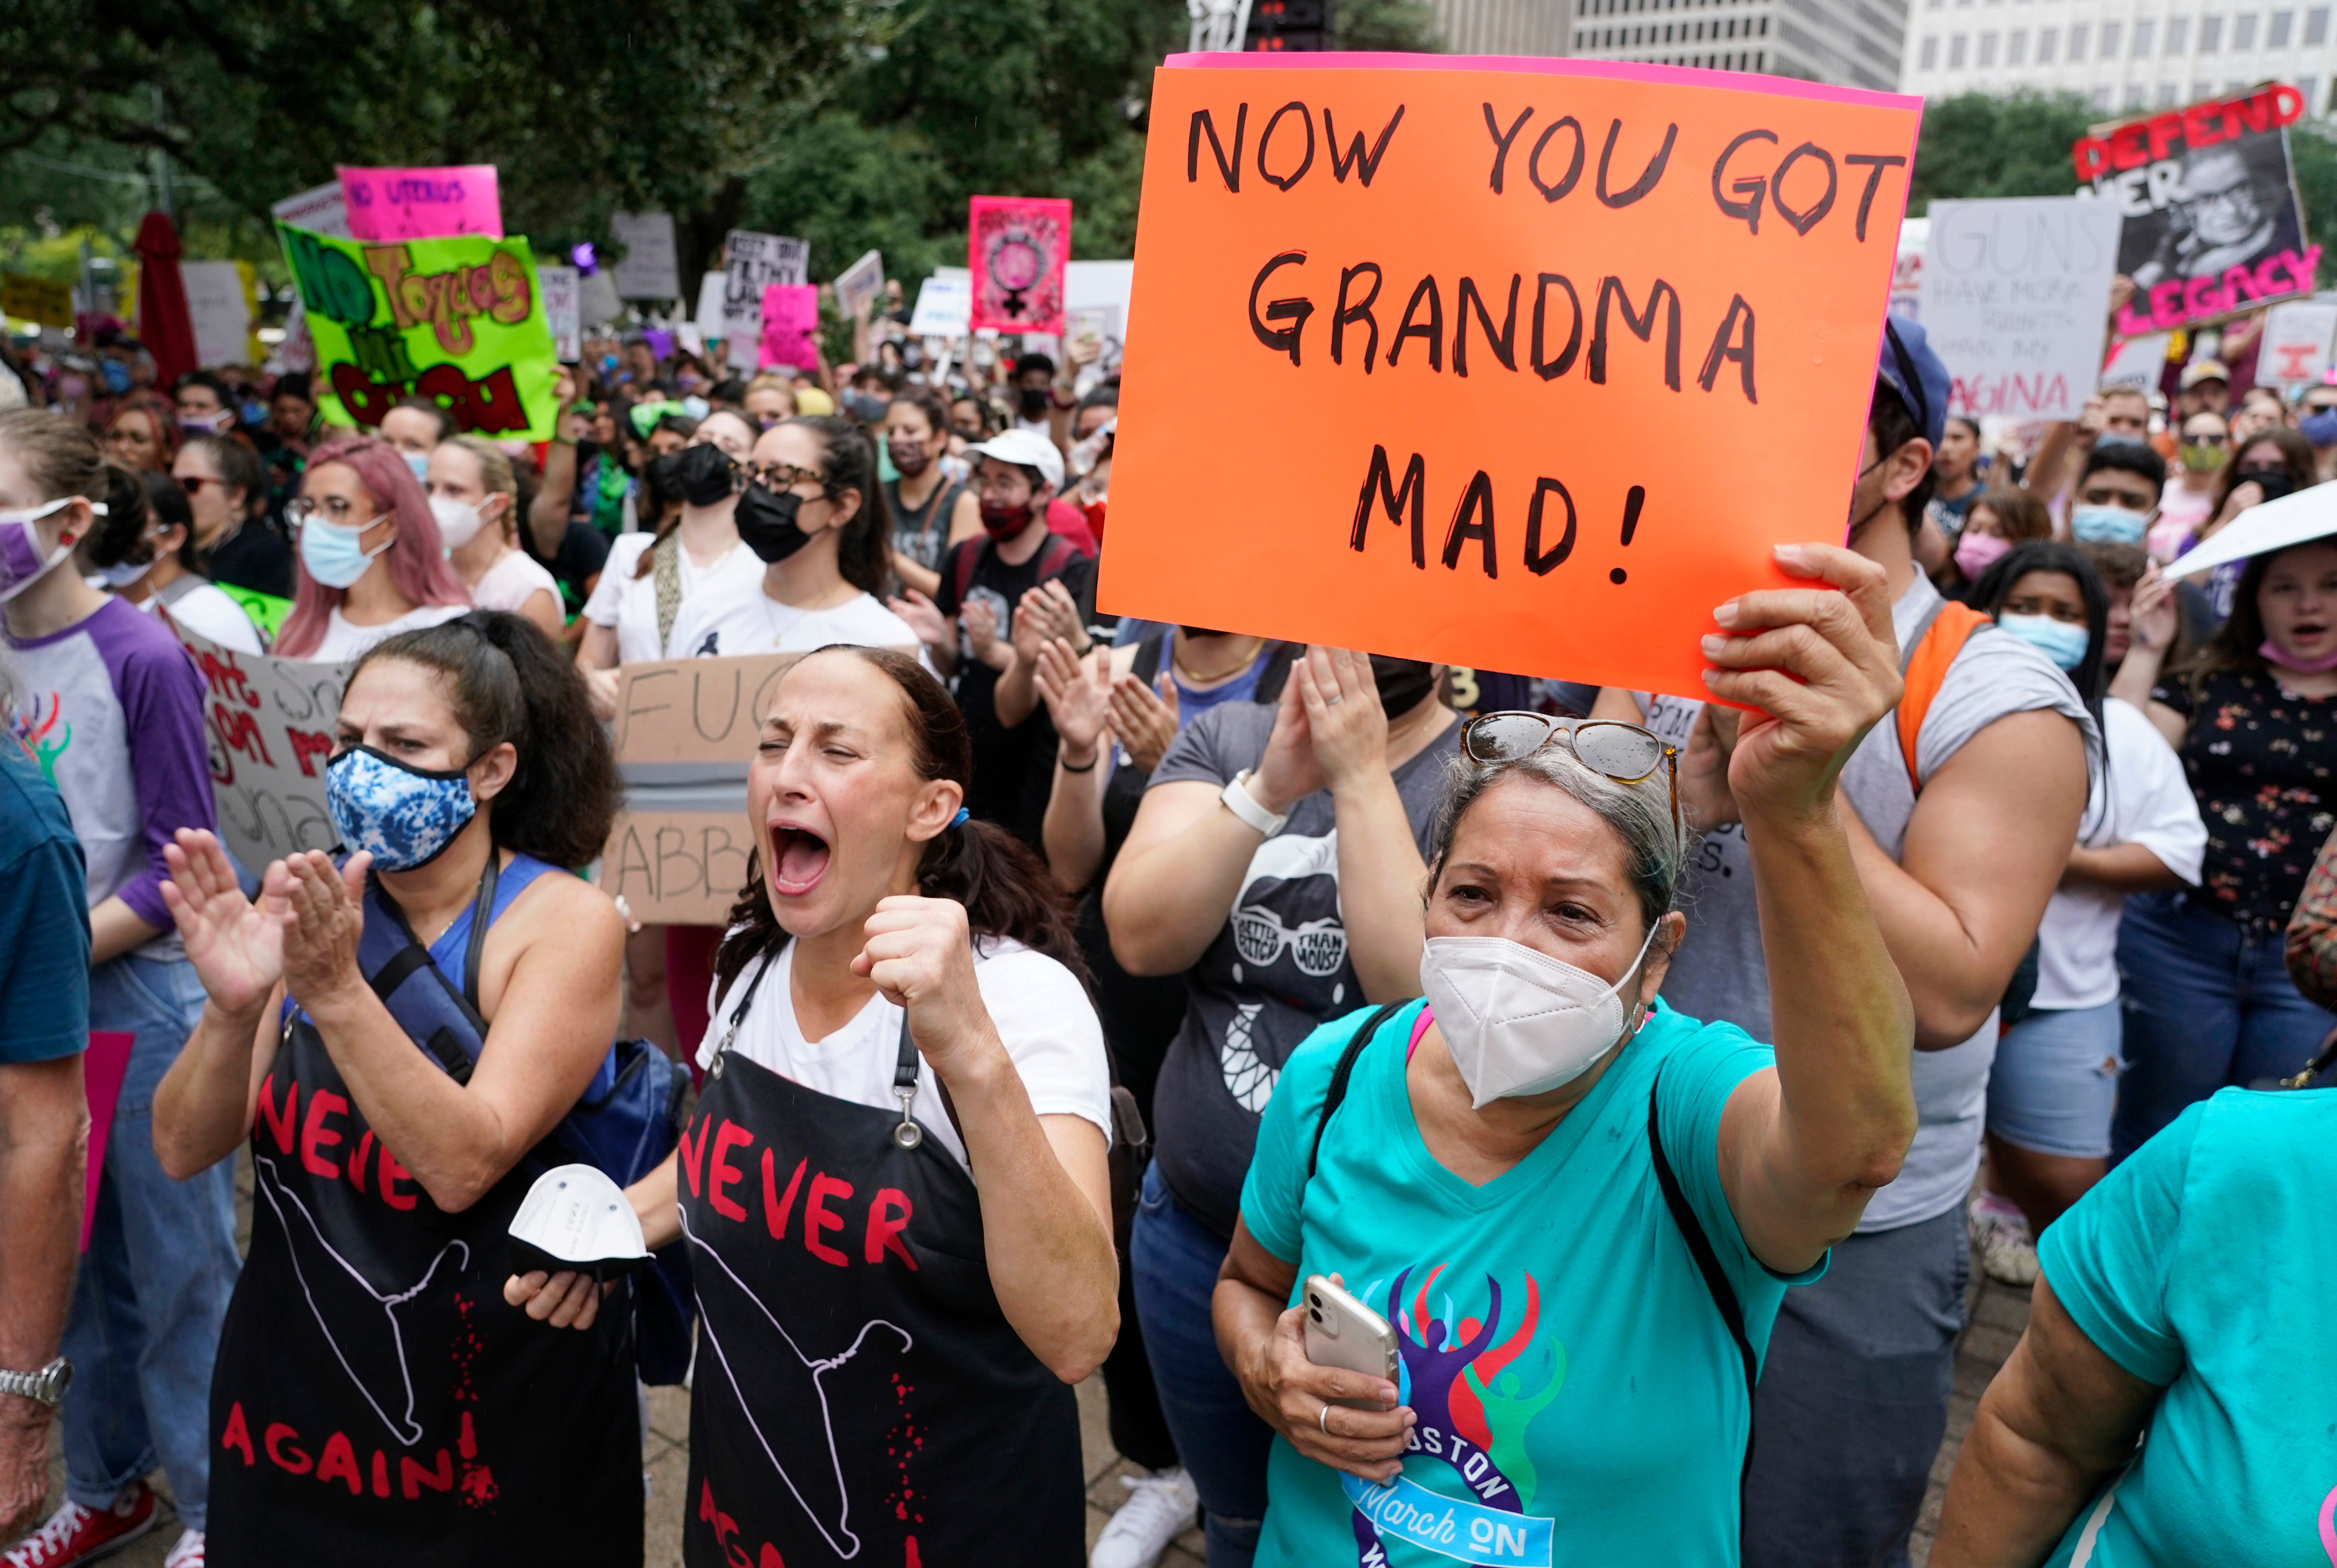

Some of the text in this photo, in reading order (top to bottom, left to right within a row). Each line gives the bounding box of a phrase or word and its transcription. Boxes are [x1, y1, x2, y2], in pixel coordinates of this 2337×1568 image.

[1187, 101, 1906, 242] NOW YOU GOT
[2072, 83, 2303, 182] DEFEND
[349, 182, 372, 207] NO
[281, 226, 375, 325] NO
[1936, 205, 2106, 277] GUNS
[1248, 251, 1757, 404] GRANDMA
[1932, 277, 2086, 307] HAVE MORE
[2116, 243, 2323, 336] LEGACY
[1947, 371, 2070, 414] AGINA
[1349, 443, 1646, 586] MAD!
[620, 658, 794, 752] FUC
[616, 824, 753, 904] ABB
[1238, 919, 1279, 942] BETTER
[1239, 934, 1279, 961] BITCH
[1296, 946, 1341, 971] MOUSE
[1299, 933, 1342, 950] THAN
[255, 1073, 417, 1211] NEVE
[679, 1112, 919, 1271] NEVER
[1354, 1484, 1527, 1557] March ON
